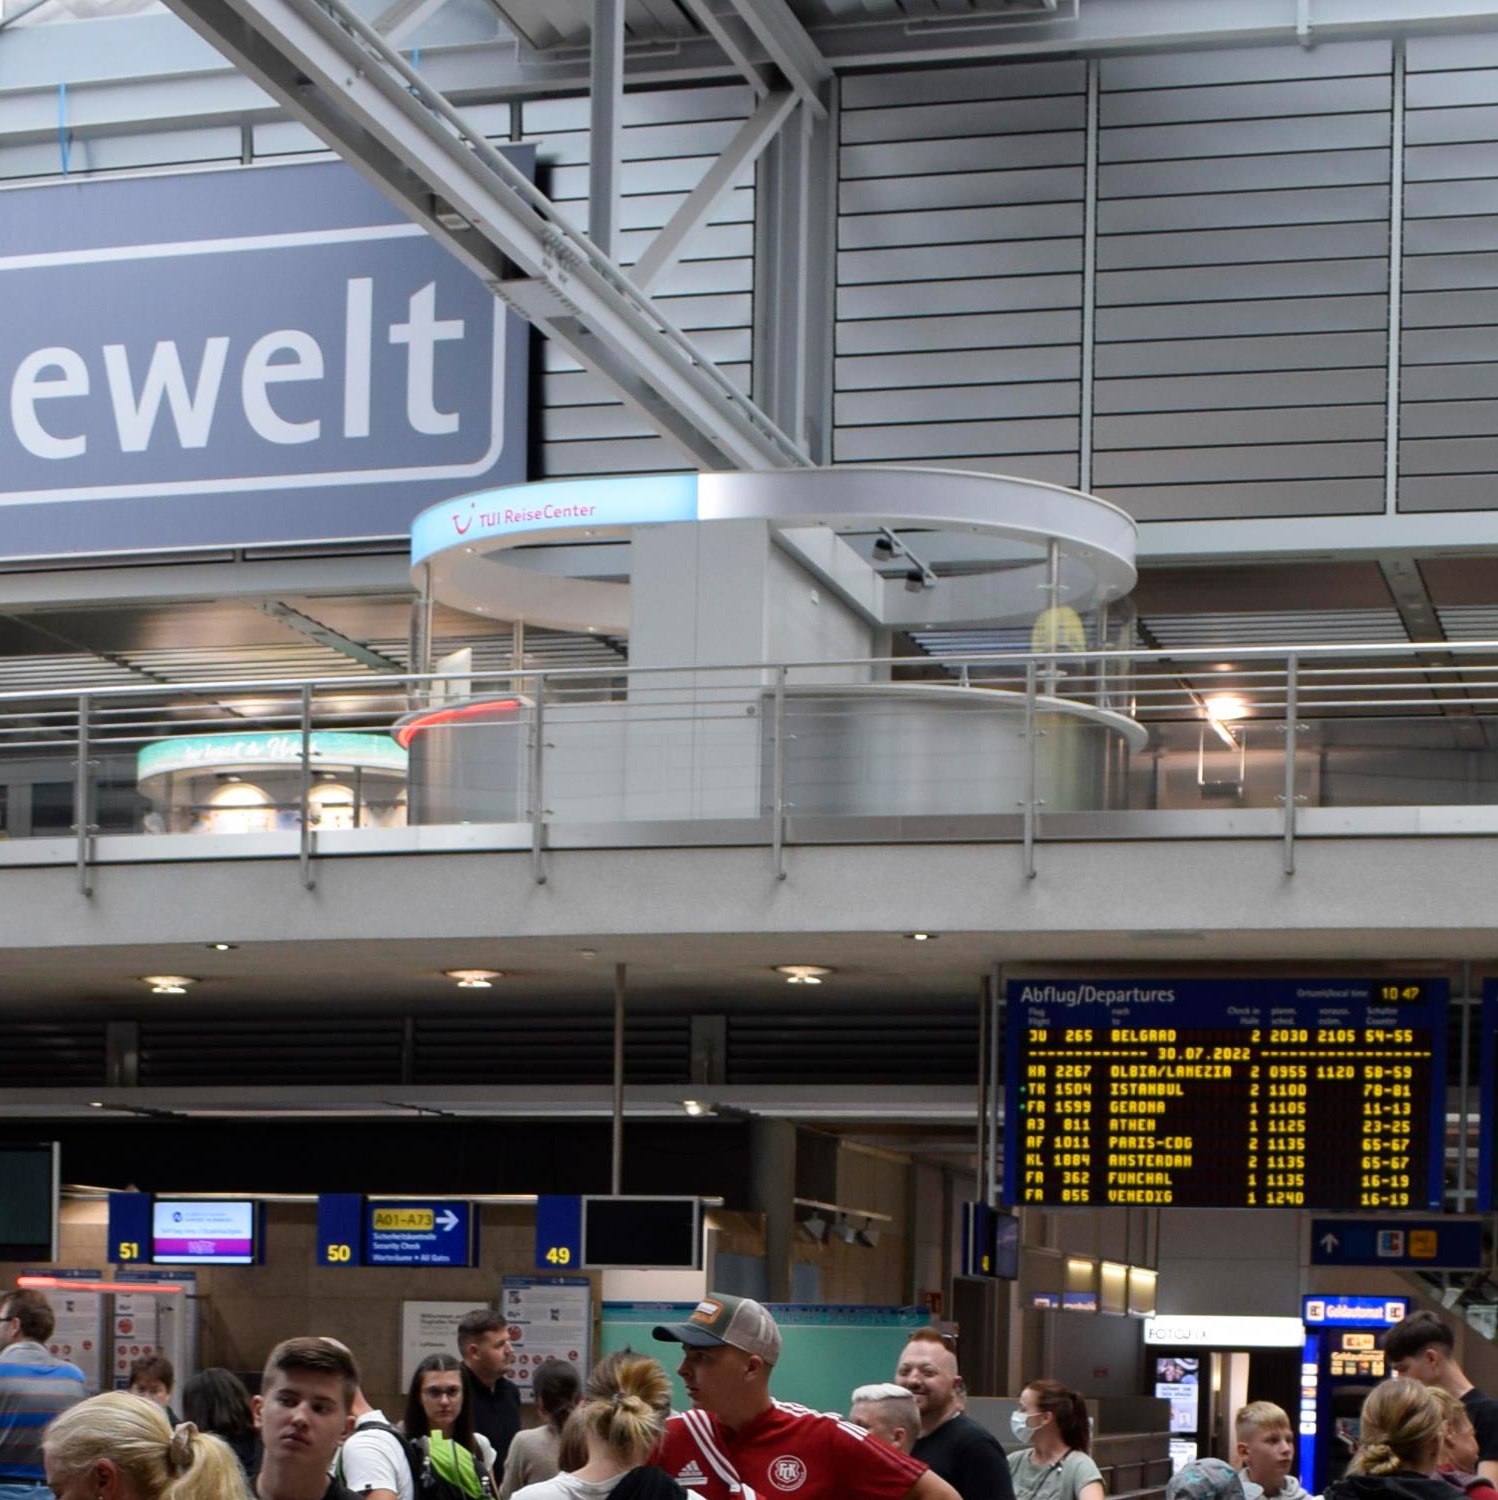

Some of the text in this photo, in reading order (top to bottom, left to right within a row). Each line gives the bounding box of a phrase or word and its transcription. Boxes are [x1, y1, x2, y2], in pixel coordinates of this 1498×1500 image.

[479, 504, 597, 529] TUI ReiseCenter
[1020, 986, 1176, 1007] Abflug/Departures
[1064, 1029, 1356, 1045] 265 BELGRAD 2030 2105
[1157, 1047, 1252, 1062] 30.07.2022
[1054, 1065, 1356, 1081] 2267 OLBIA/LAMEZIA 0955 1120
[1054, 1083, 1308, 1099] 1504 ISTANBUL 1100
[1054, 1100, 1307, 1117] 1599 GERONA 1105
[1062, 1118, 1306, 1134] 811 ATHEN 1125
[1053, 1136, 1306, 1153] 1011 PARIS-CDG 1135
[1053, 1154, 1306, 1171] 1884 AMSTERDAM 1135
[1062, 1171, 1305, 1189] 362 FUNCHAL 1135
[1061, 1189, 1305, 1206] 855 VENEDIG 1240
[119, 1242, 140, 1259] 51
[328, 1245, 351, 1261] 50
[546, 1247, 570, 1265] 49
